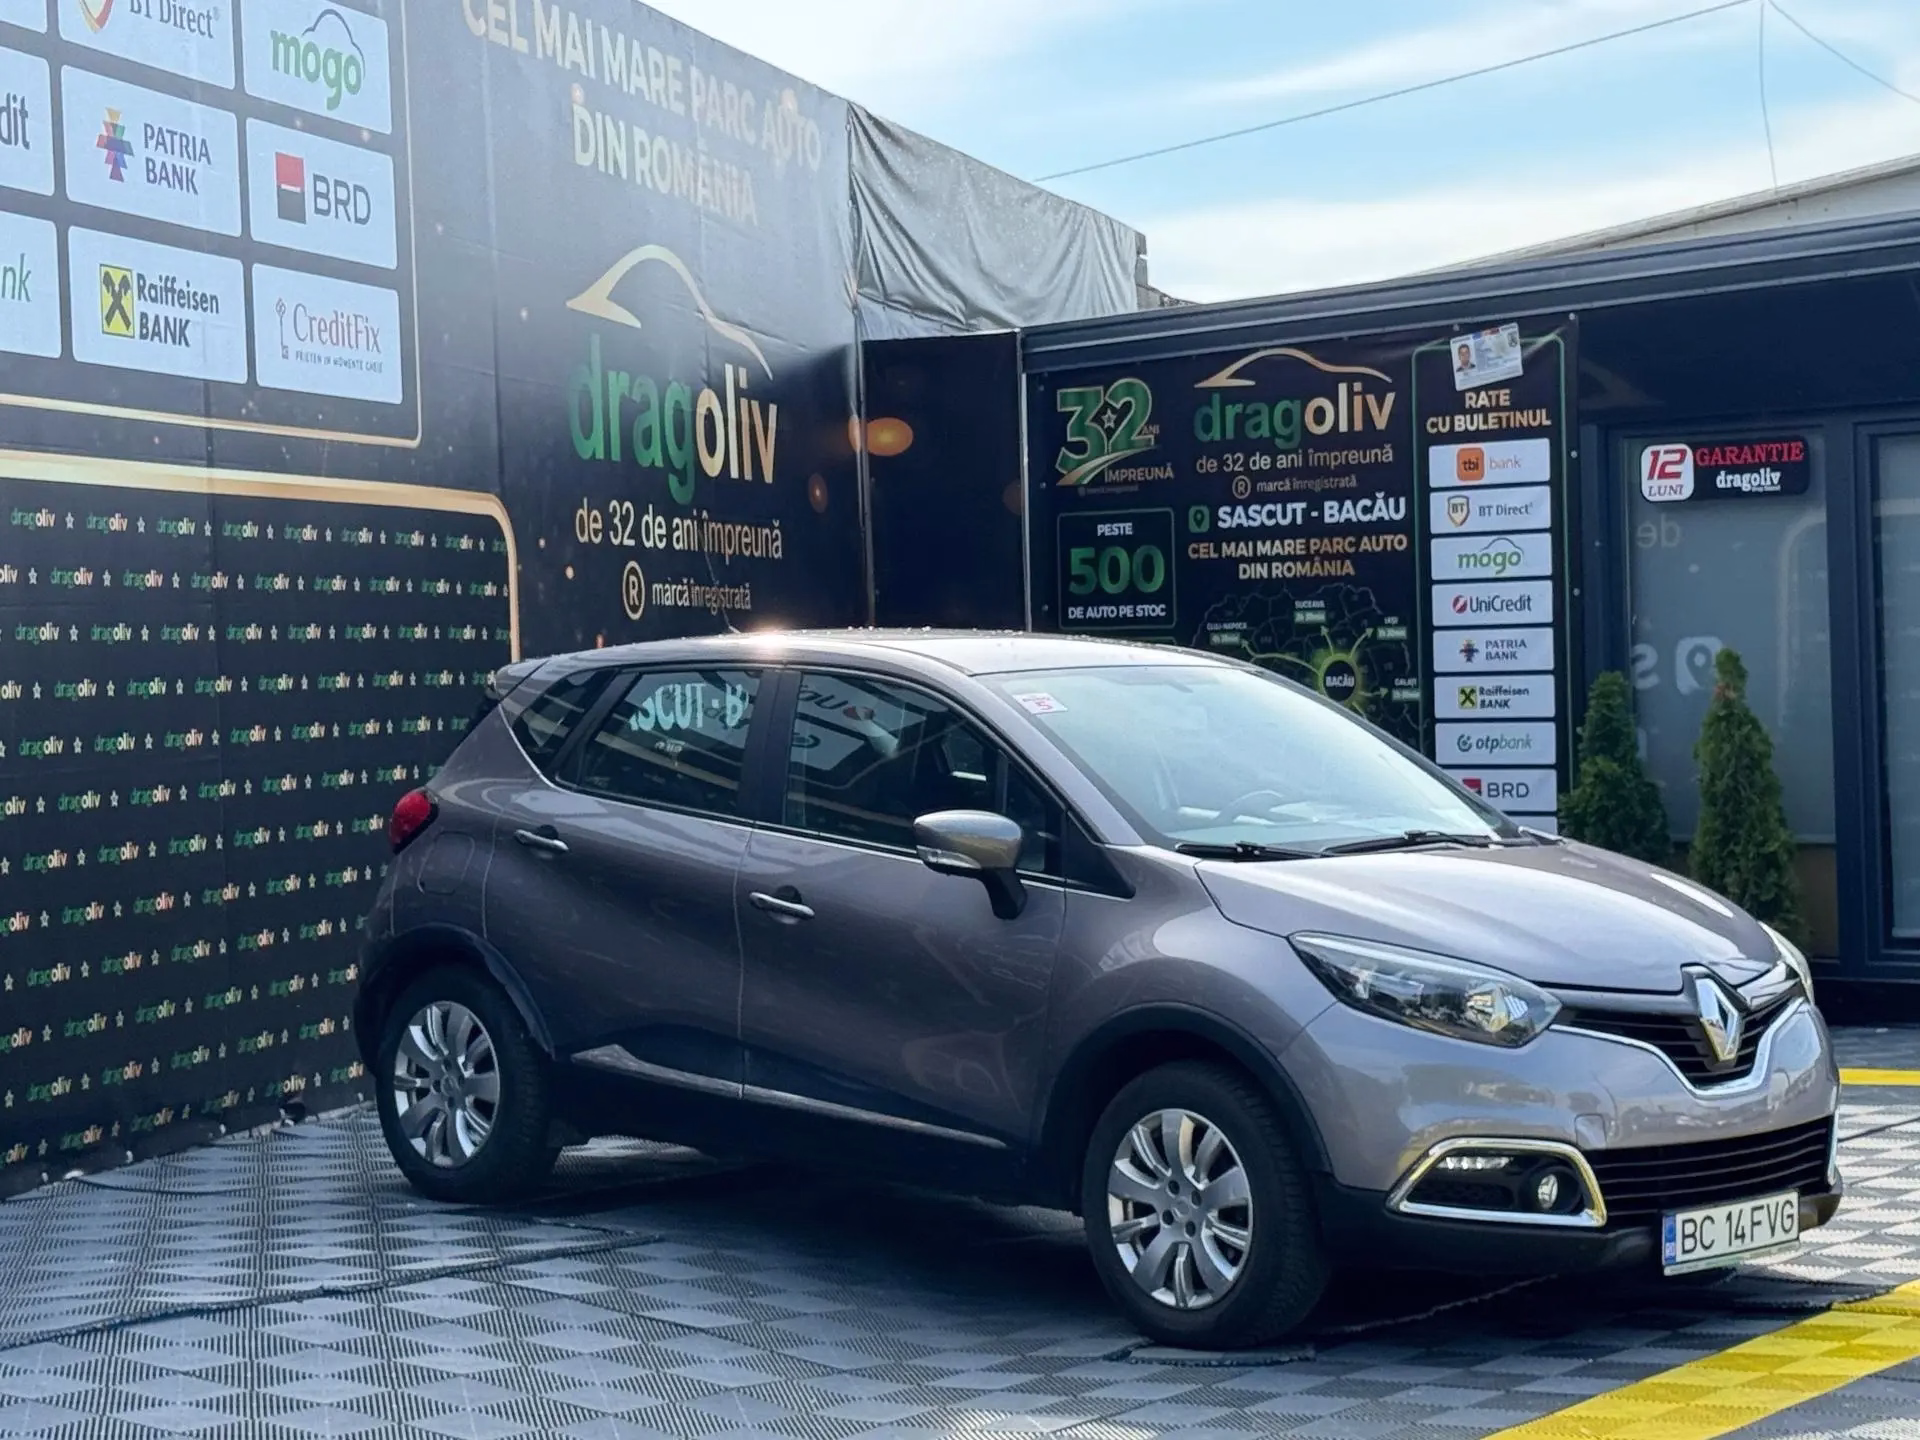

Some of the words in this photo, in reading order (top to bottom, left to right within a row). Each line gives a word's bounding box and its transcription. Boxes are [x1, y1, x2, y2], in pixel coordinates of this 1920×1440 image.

[270, 30, 363, 110] mogo
[462, 0, 529, 54] CEL
[533, 0, 596, 80] MAI
[600, 24, 686, 117] MARE
[689, 64, 757, 146] PARC
[761, 95, 822, 172] AUTO
[143, 122, 212, 166] PATRIA
[145, 157, 199, 196] BANK
[572, 103, 628, 181] DIN
[633, 126, 758, 227] ROMÂNIA
[312, 172, 371, 225] BRD
[136, 272, 219, 315] Raiffeisen
[138, 311, 190, 348] BANK
[293, 303, 382, 354] CreditFix
[1194, 381, 1396, 449] dragoliv
[1465, 388, 1511, 410] RATE
[568, 333, 778, 506] dragoliv
[1055, 377, 1155, 477] 32
[1426, 416, 1451, 434] CU
[1454, 408, 1552, 433] BULETINUL
[1196, 456, 1218, 473] de
[1223, 452, 1245, 472] 32
[1250, 451, 1271, 470] de
[1276, 449, 1303, 469] ani
[1308, 443, 1394, 469] împreună
[1462, 457, 1479, 472] tbi
[1489, 455, 1522, 470] bank
[1646, 448, 1688, 480] 12
[1695, 441, 1804, 466] GARANTIE
[1256, 478, 1291, 493] marcă
[1648, 484, 1684, 497] LUNI
[1716, 466, 1781, 492] dragoliv
[10, 507, 56, 531] dragoliv
[86, 512, 129, 535] dragoliv
[155, 516, 196, 539] dragoliv
[222, 519, 259, 542] dragoliv
[283, 523, 319, 544] dragoliv
[1217, 502, 1307, 529] SASCUT
[1323, 491, 1407, 524] BACĂU
[1478, 504, 1493, 517] BT
[575, 497, 602, 544] de
[608, 500, 636, 546] 32
[641, 504, 667, 549] de
[672, 508, 700, 552] ani
[702, 510, 783, 565] împreună
[1097, 522, 1134, 536] PESTE
[1188, 543, 1219, 559] CEL
[1222, 540, 1254, 558] MAI
[1256, 538, 1306, 557] MARE
[1310, 536, 1356, 555] PARC
[1359, 533, 1409, 552] AUTO
[1068, 544, 1166, 595] 500
[1239, 563, 1269, 580] DIN
[1272, 557, 1355, 579] ROMÂNIA
[1458, 550, 1522, 575] mogo
[49, 566, 94, 589] dragoliv
[122, 568, 164, 592] dragoliv
[190, 570, 230, 593] dragoliv
[254, 572, 290, 594] dragoliv
[652, 578, 690, 608] marcă
[1068, 606, 1085, 619] DE
[1086, 605, 1118, 619] AUTO
[1119, 604, 1134, 617] PE
[1135, 602, 1167, 617] STOC
[1469, 594, 1533, 613] UniCredit
[14, 621, 61, 646] dragoliv
[90, 621, 133, 645] dragoliv
[159, 622, 200, 645] dragoliv
[225, 622, 263, 645] dragoliv
[1485, 638, 1528, 650] PATRIA
[1485, 649, 1518, 661] BANK
[53, 677, 98, 702] dragoliv
[126, 676, 168, 700] dragoliv
[194, 674, 233, 698] dragoliv
[258, 672, 294, 695] dragoliv
[1478, 685, 1530, 697] Raiffeisen
[1479, 699, 1511, 709] BANK
[18, 735, 64, 761] dragoliv
[93, 731, 136, 756] dragoliv
[163, 727, 204, 752] dragoliv
[229, 724, 269, 747] dragoliv
[1475, 733, 1533, 753] otpbank
[57, 789, 102, 814] dragoliv
[129, 783, 172, 808] dragoliv
[197, 778, 237, 802] dragoliv
[261, 773, 298, 796] dragoliv
[1487, 782, 1530, 799] BRD
[23, 848, 69, 875] dragoliv
[96, 840, 140, 866] dragoliv
[167, 833, 208, 857] dragoliv
[233, 826, 272, 849] dragoliv
[294, 819, 330, 842] dragoliv
[61, 900, 105, 927] dragoliv
[133, 891, 175, 916] dragoliv
[201, 882, 241, 907] dragoliv
[266, 873, 302, 896] dragoliv
[26, 962, 72, 988] dragoliv
[101, 950, 145, 976] dragoliv
[170, 939, 213, 964] dragoliv
[237, 927, 276, 953] dragoliv
[63, 1012, 108, 1039] dragoliv
[135, 999, 177, 1024] dragoliv
[204, 985, 243, 1011] dragoliv
[268, 973, 306, 998] dragoliv
[26, 1075, 73, 1103] dragoliv
[102, 1060, 143, 1086] dragoliv
[170, 1044, 211, 1070] dragoliv
[237, 1029, 275, 1055] dragoliv
[299, 1017, 336, 1041] dragoliv
[59, 1124, 104, 1150] dragoliv
[265, 1074, 307, 1098] dragoliv
[1682, 1215, 1715, 1255] BC
